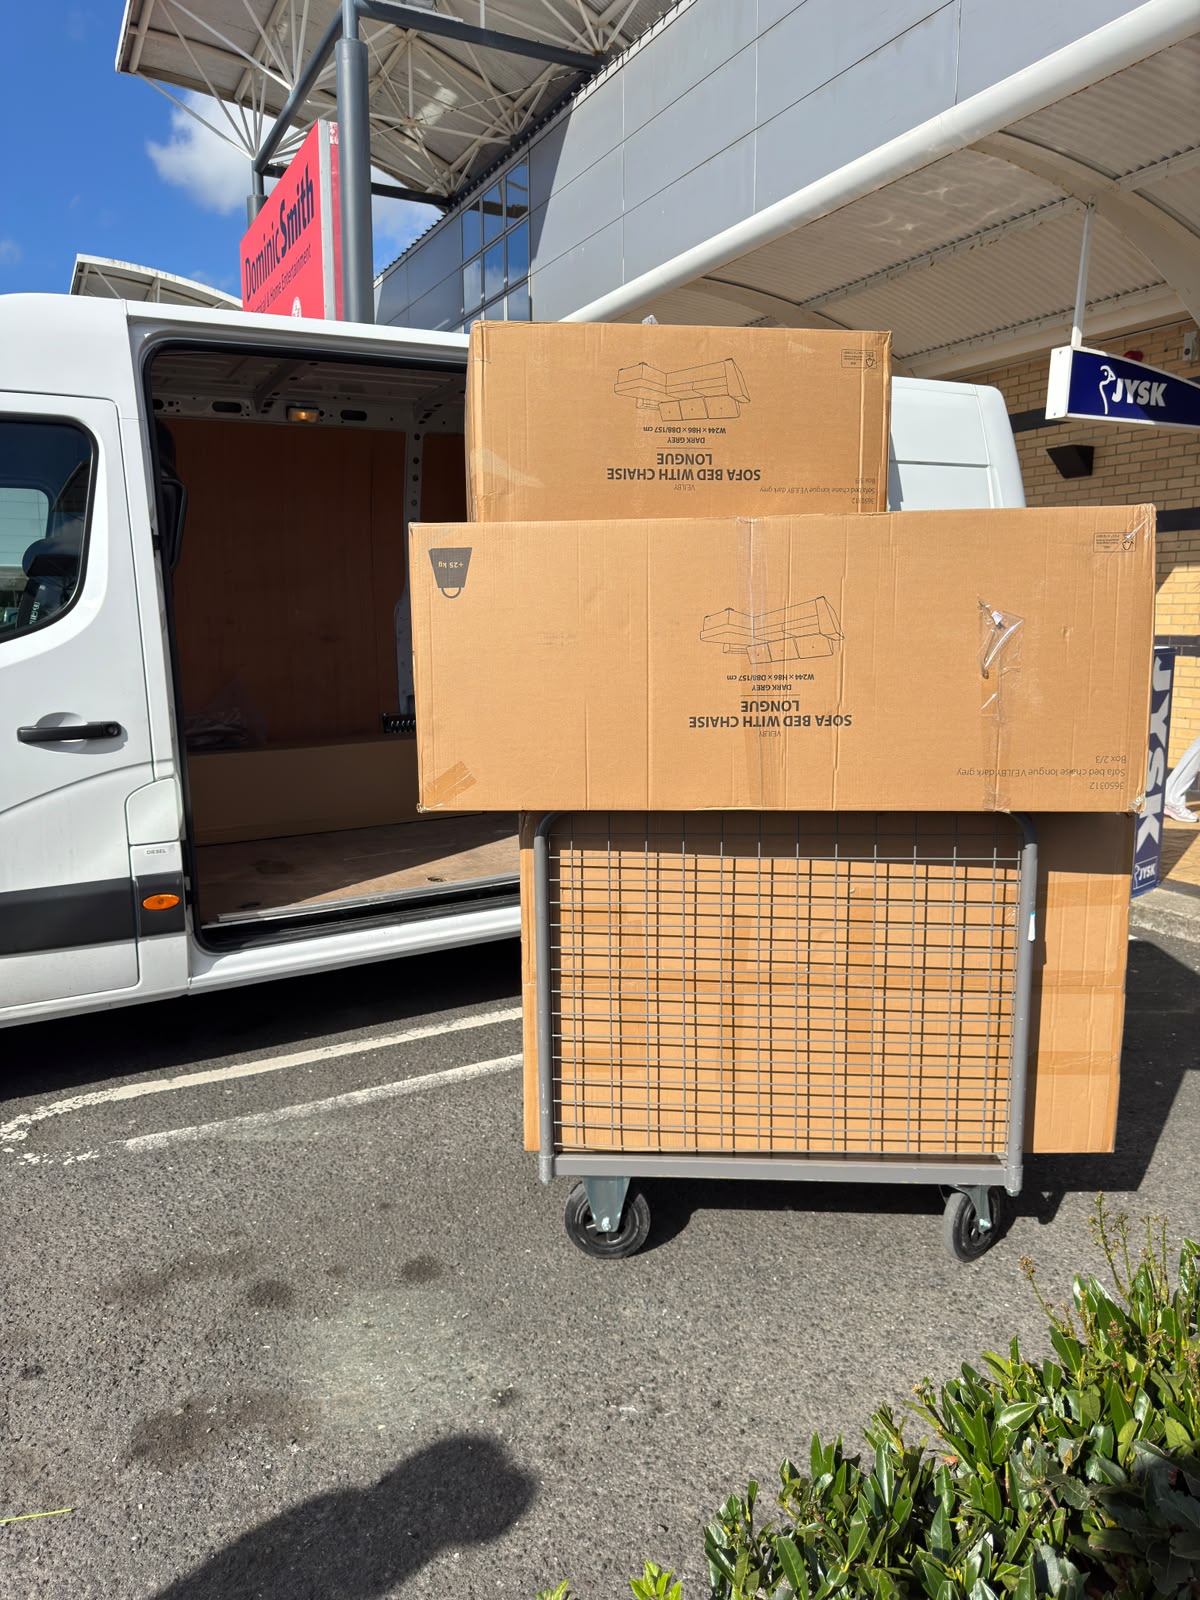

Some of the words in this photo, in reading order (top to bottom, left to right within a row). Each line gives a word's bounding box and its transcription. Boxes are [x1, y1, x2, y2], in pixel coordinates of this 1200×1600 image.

[270, 282, 282, 301] Home
[281, 244, 312, 291] Entertainment
[1112, 378, 1168, 406] JYSK
[654, 426, 681, 434] D88/157
[688, 426, 701, 434] H86
[708, 426, 726, 434] W244
[656, 453, 713, 466] LONGUE
[607, 468, 656, 481] CHAISE
[658, 468, 694, 481] WITH
[694, 468, 723, 481] BED
[726, 468, 761, 480] SOFA
[740, 700, 800, 712] LONGUE
[688, 716, 739, 728] CHAISE
[743, 716, 780, 728] WITH
[783, 715, 811, 727] BED
[815, 714, 852, 726] SOFA
[1095, 755, 1108, 763] 2/3
[1110, 755, 1126, 763] Box
[1136, 656, 1172, 852] JYSK
[956, 767, 975, 776] grey
[977, 769, 995, 777] dark
[1028, 766, 1058, 777] longue
[1061, 769, 1087, 777] chaise
[1088, 769, 1105, 777] bed
[1107, 768, 1125, 777] Sofa
[1138, 863, 1156, 881] JYSK
